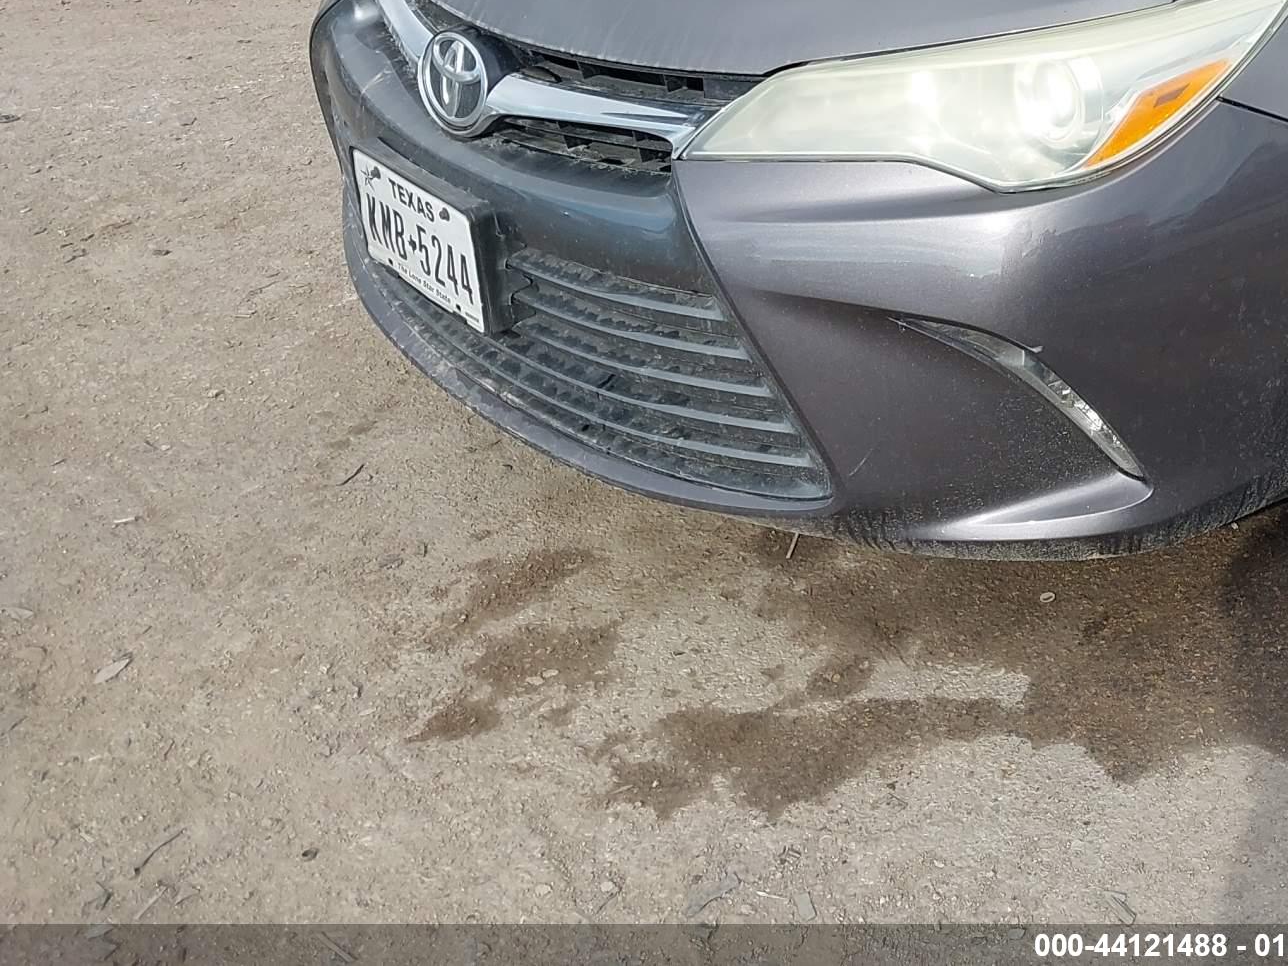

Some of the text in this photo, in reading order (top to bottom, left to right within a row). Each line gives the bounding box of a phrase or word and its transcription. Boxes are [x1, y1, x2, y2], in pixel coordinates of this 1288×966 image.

[388, 177, 435, 222] TEXAS
[397, 262, 451, 305] The Lone Star State
